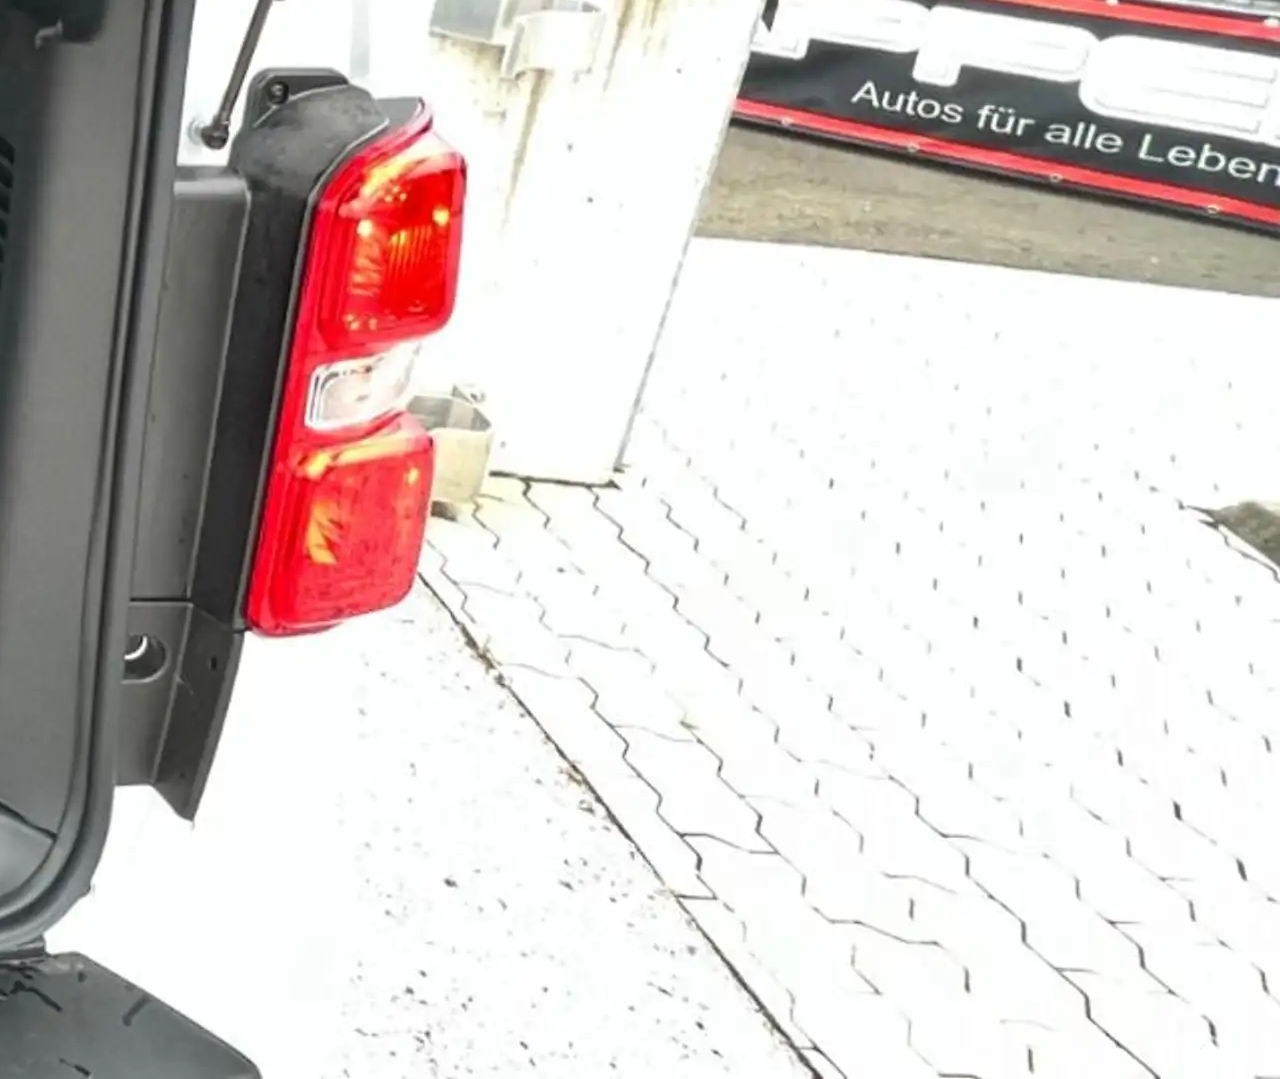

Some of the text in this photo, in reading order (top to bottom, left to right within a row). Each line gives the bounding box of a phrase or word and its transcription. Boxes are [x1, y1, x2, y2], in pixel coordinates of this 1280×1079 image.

[850, 80, 965, 124] Autos
[976, 104, 1035, 138] für
[1044, 122, 1124, 154] alle
